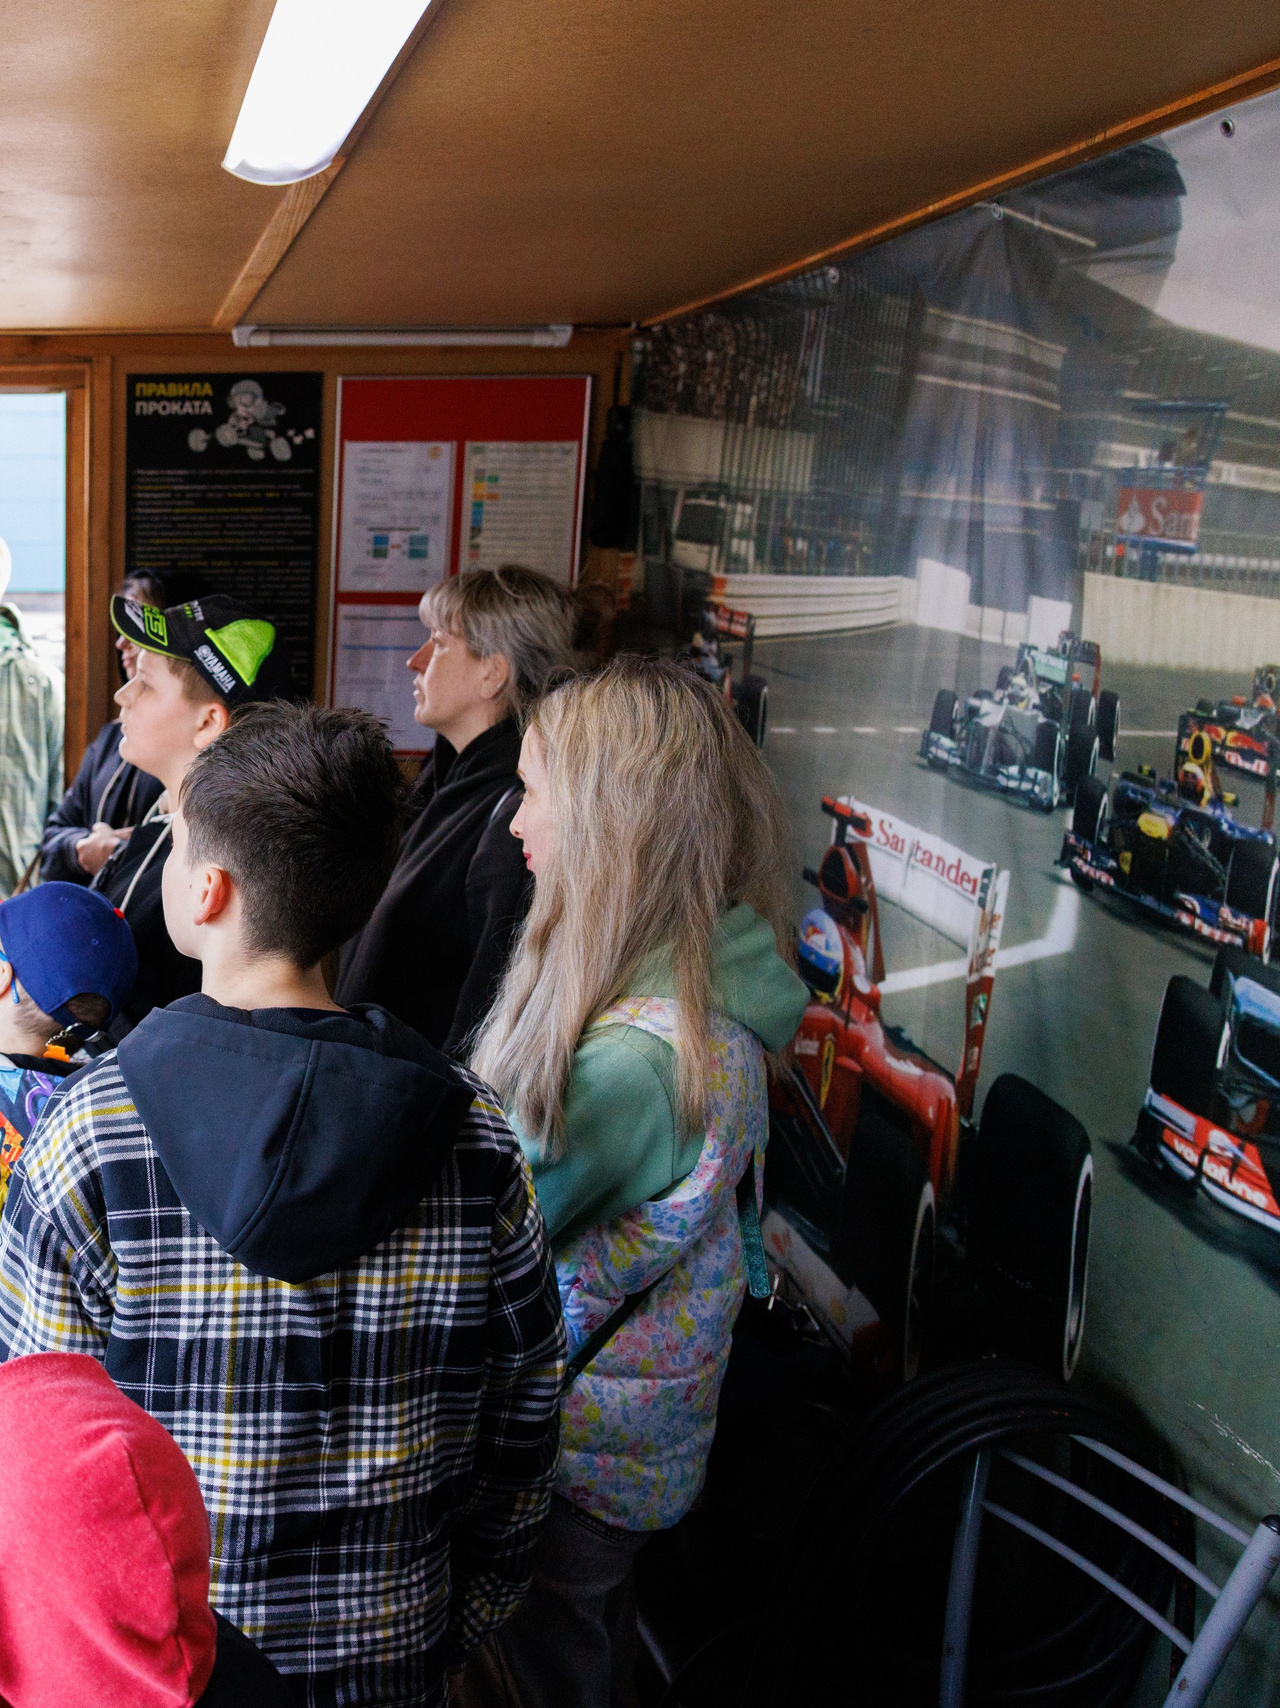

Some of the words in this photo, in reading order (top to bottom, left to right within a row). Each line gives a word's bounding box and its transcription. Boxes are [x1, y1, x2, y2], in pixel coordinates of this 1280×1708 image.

[135, 382, 213, 398] ПРАВИЛА
[135, 400, 213, 416] ПРОКАТА
[203, 651, 236, 692] YAMAHA
